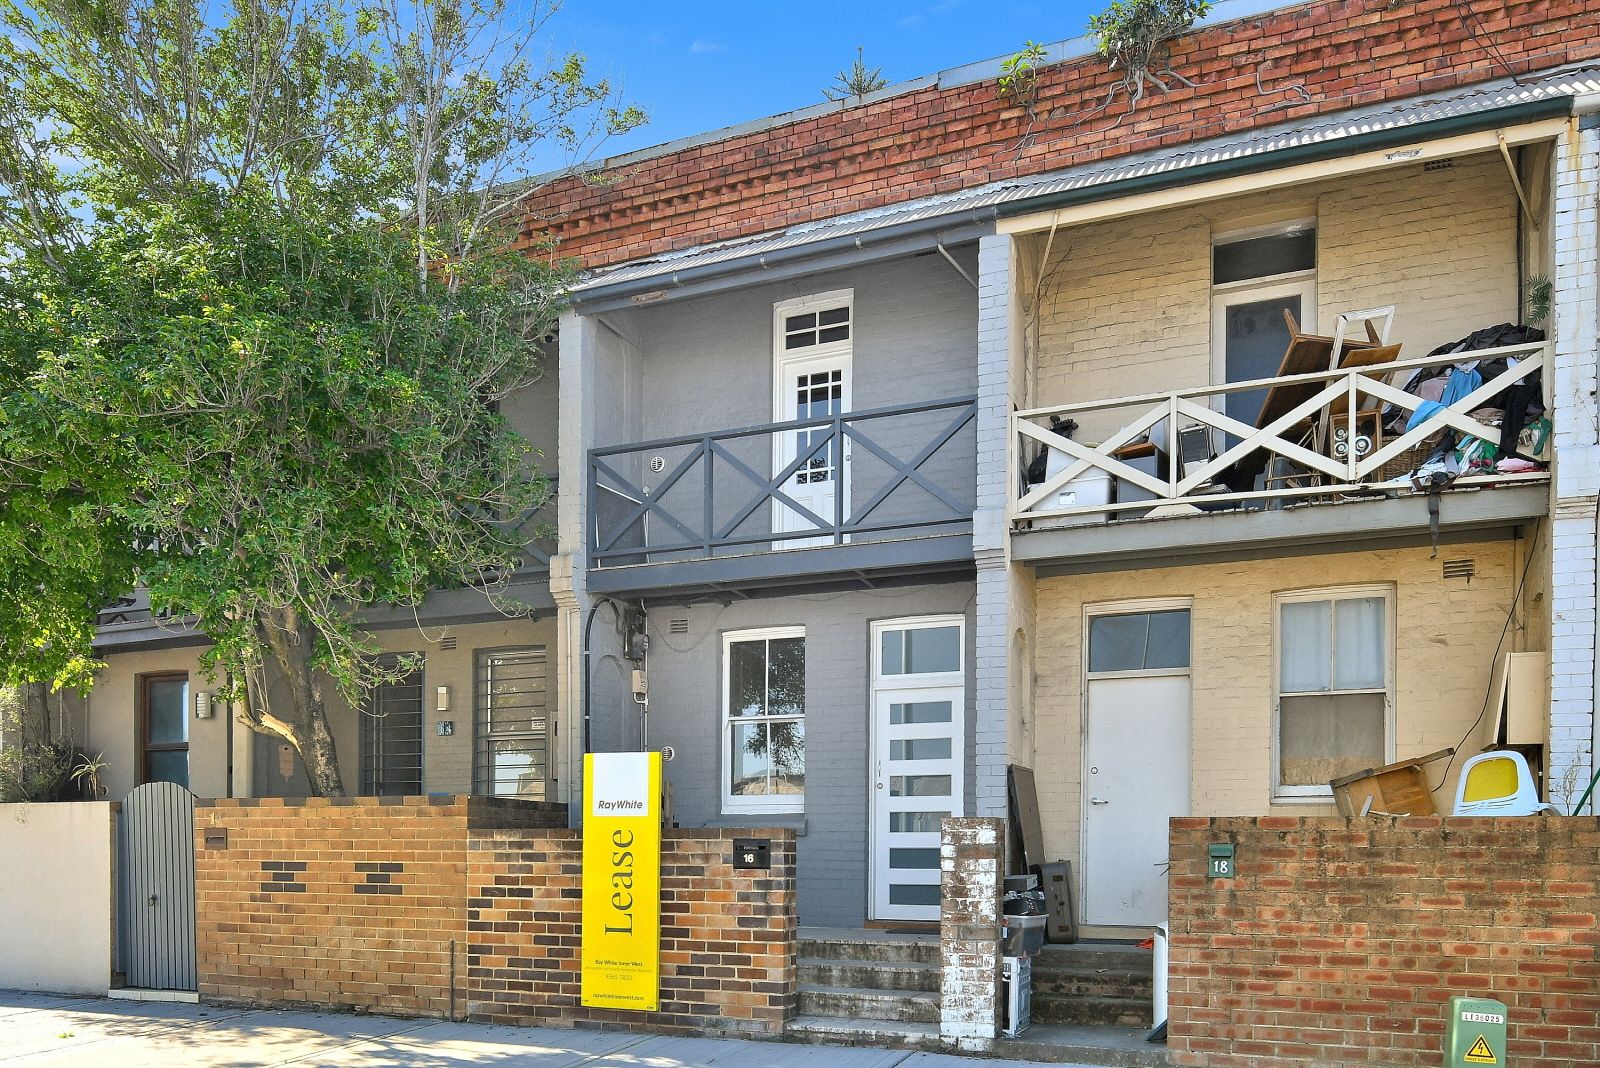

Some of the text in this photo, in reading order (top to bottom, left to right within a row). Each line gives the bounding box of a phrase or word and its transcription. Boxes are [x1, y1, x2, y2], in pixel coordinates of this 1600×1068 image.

[743, 853, 754, 863] 16
[1213, 860, 1229, 874] 18
[604, 829, 634, 937] Lease
